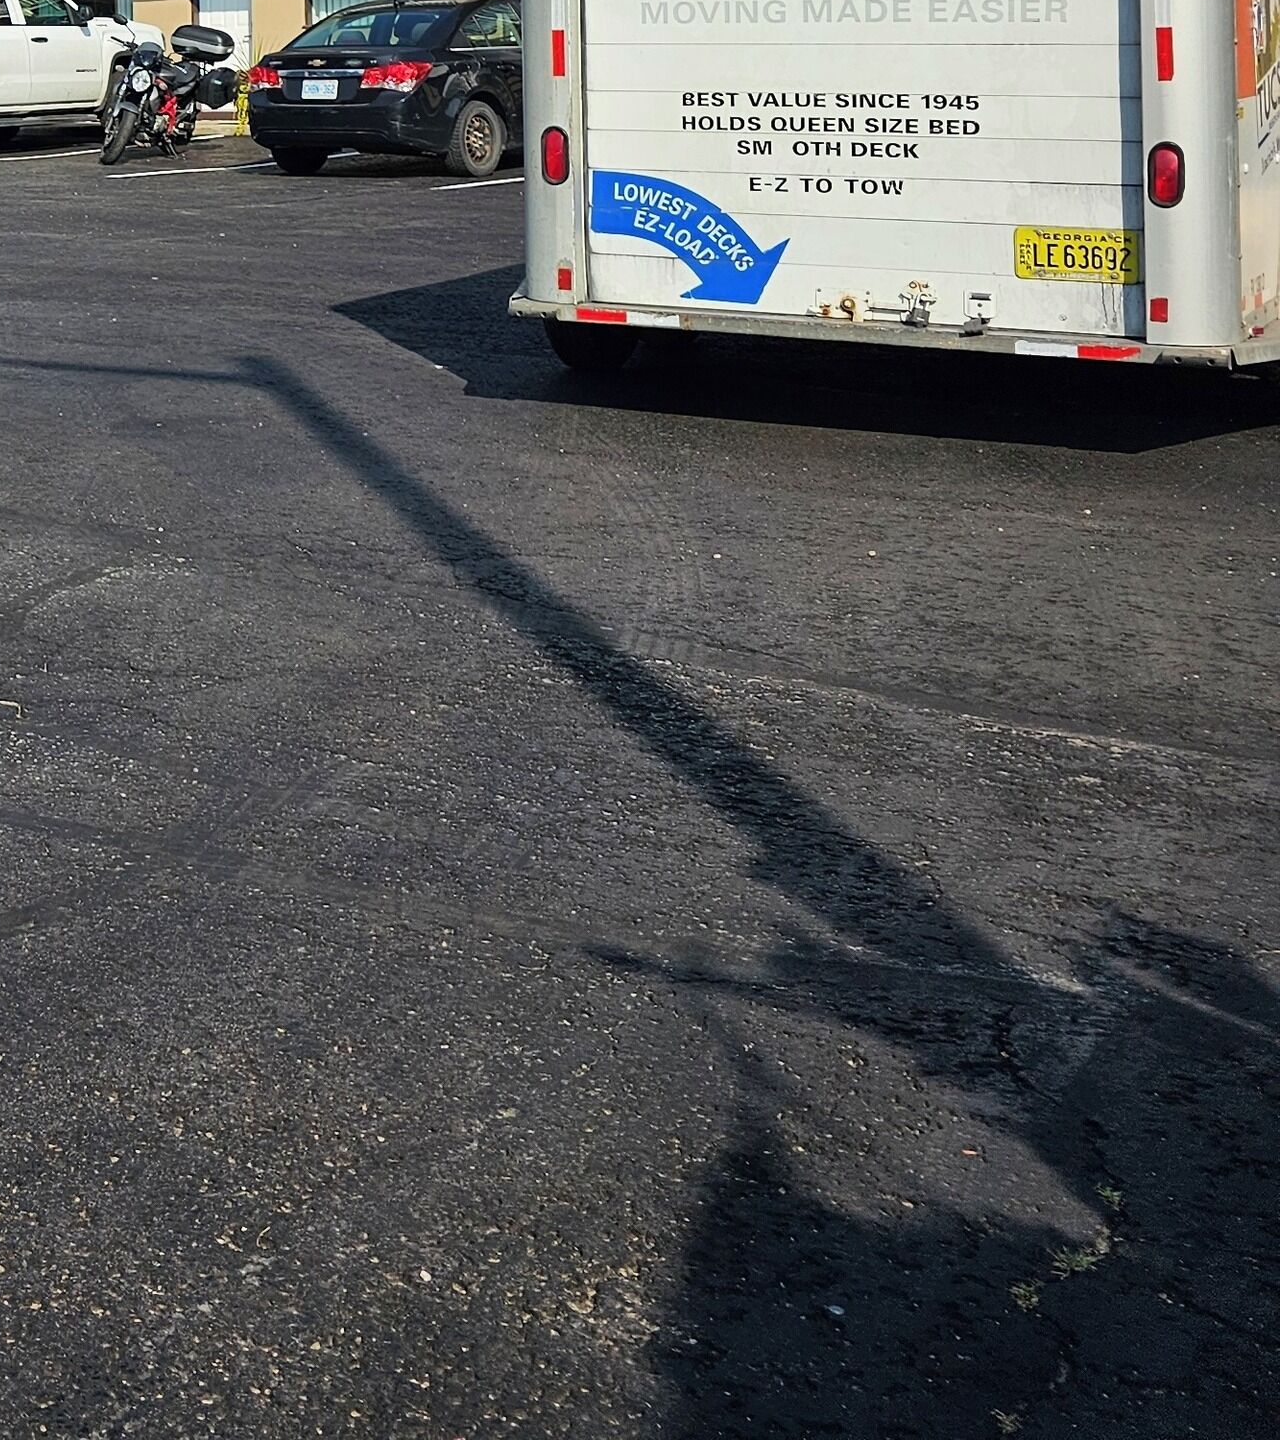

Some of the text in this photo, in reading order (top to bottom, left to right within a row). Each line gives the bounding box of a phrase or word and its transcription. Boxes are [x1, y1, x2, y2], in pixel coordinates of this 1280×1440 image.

[640, 0, 787, 25] MOVING
[682, 92, 979, 110] BEST VALUE SINCE 1945
[682, 116, 981, 136] HOLDS QUEEN SIZE BED
[851, 142, 920, 159] DECK
[749, 177, 904, 195] E-Z TO TOW
[613, 181, 755, 272] LOWEST DECKS
[633, 209, 717, 266] EZ-LOAD
[1042, 233, 1110, 243] GEORGIA
